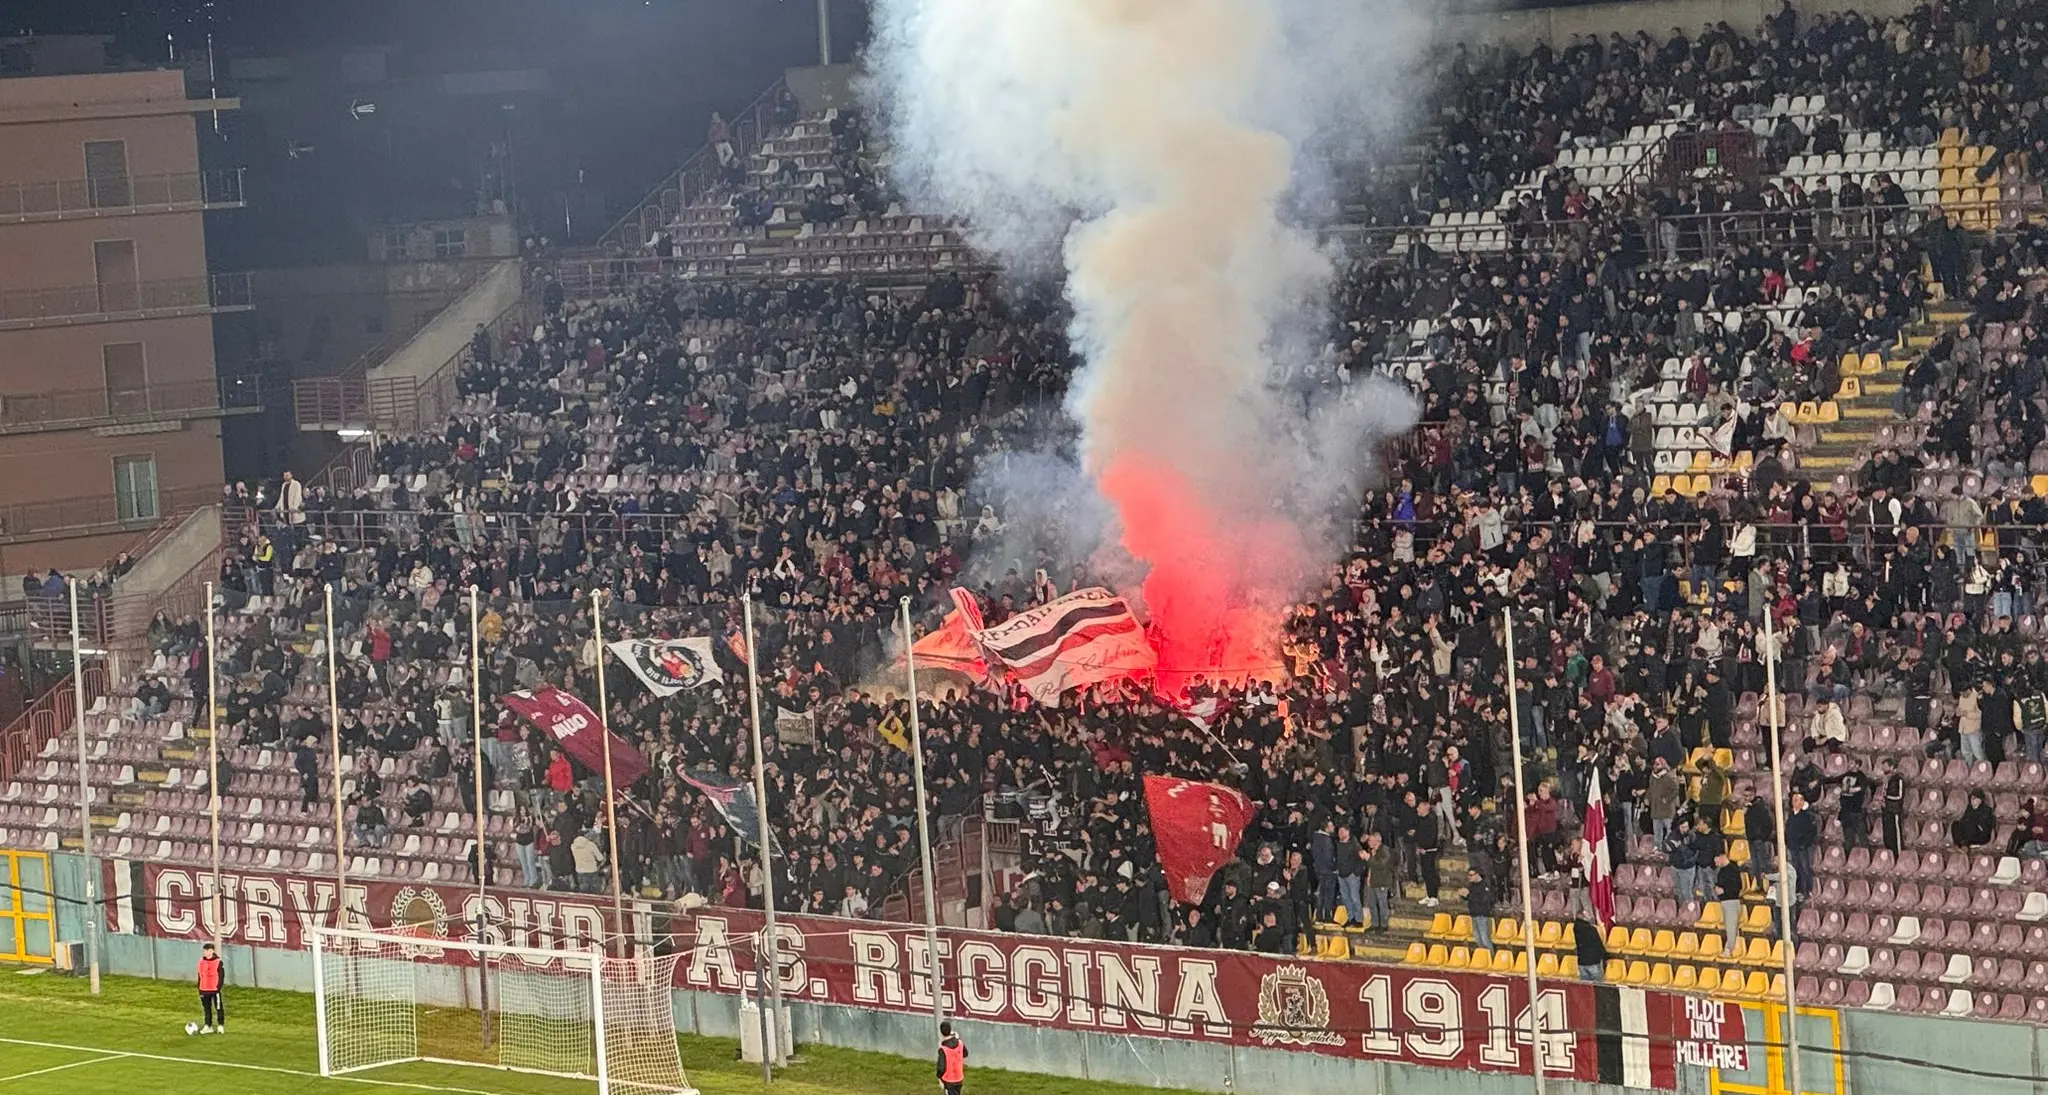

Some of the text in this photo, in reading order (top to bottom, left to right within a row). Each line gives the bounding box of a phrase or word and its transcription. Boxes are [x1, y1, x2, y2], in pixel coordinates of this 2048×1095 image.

[156, 868, 1577, 1071] CURVA SUD A.S. REGGINA 1914
[1685, 996, 1725, 1023] ALDO
[1676, 1040, 1745, 1071] MOLLARE
